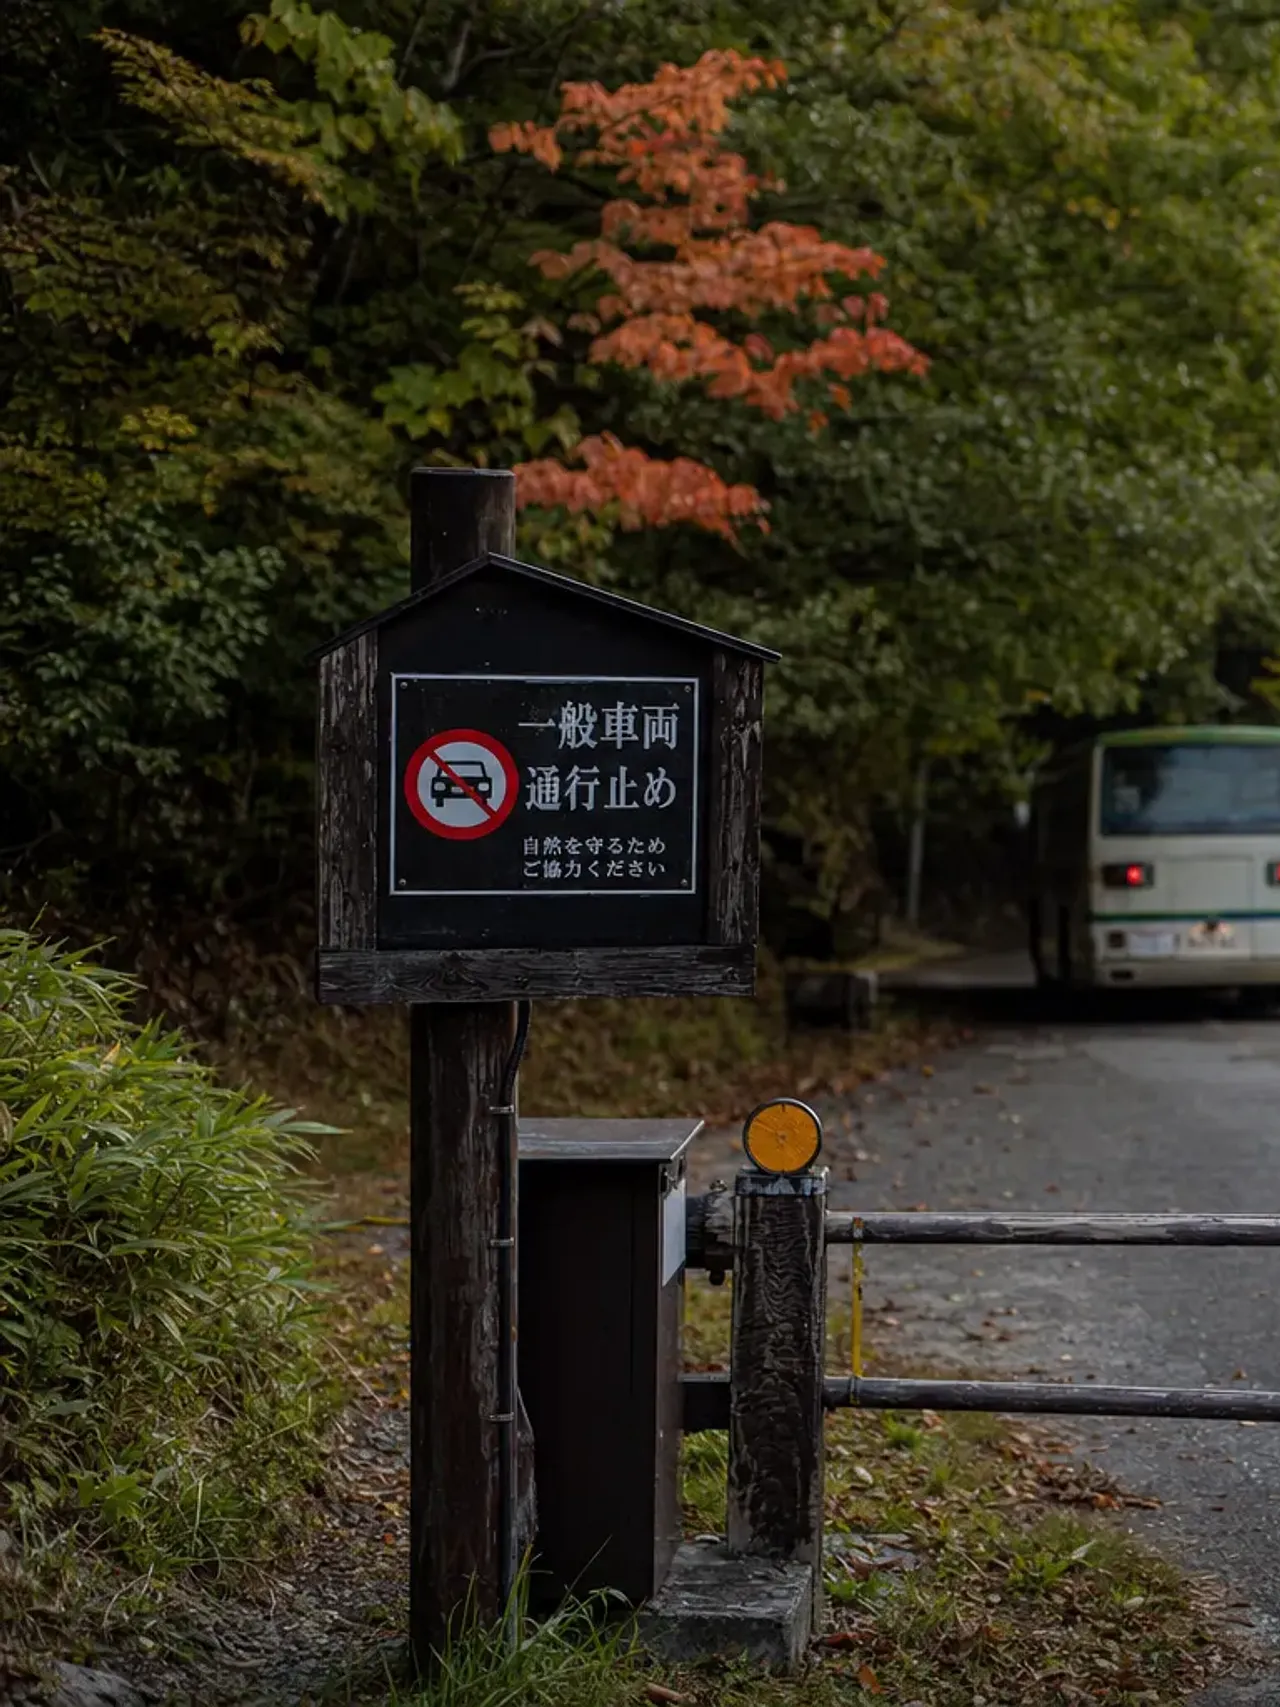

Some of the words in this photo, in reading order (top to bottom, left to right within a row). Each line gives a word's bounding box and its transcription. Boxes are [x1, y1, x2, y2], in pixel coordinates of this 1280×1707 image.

[518, 701, 680, 750] 一般車両
[525, 765, 676, 811] 通行止め
[523, 836, 666, 856] 自然を守るため
[523, 859, 666, 878] ご協力ください
